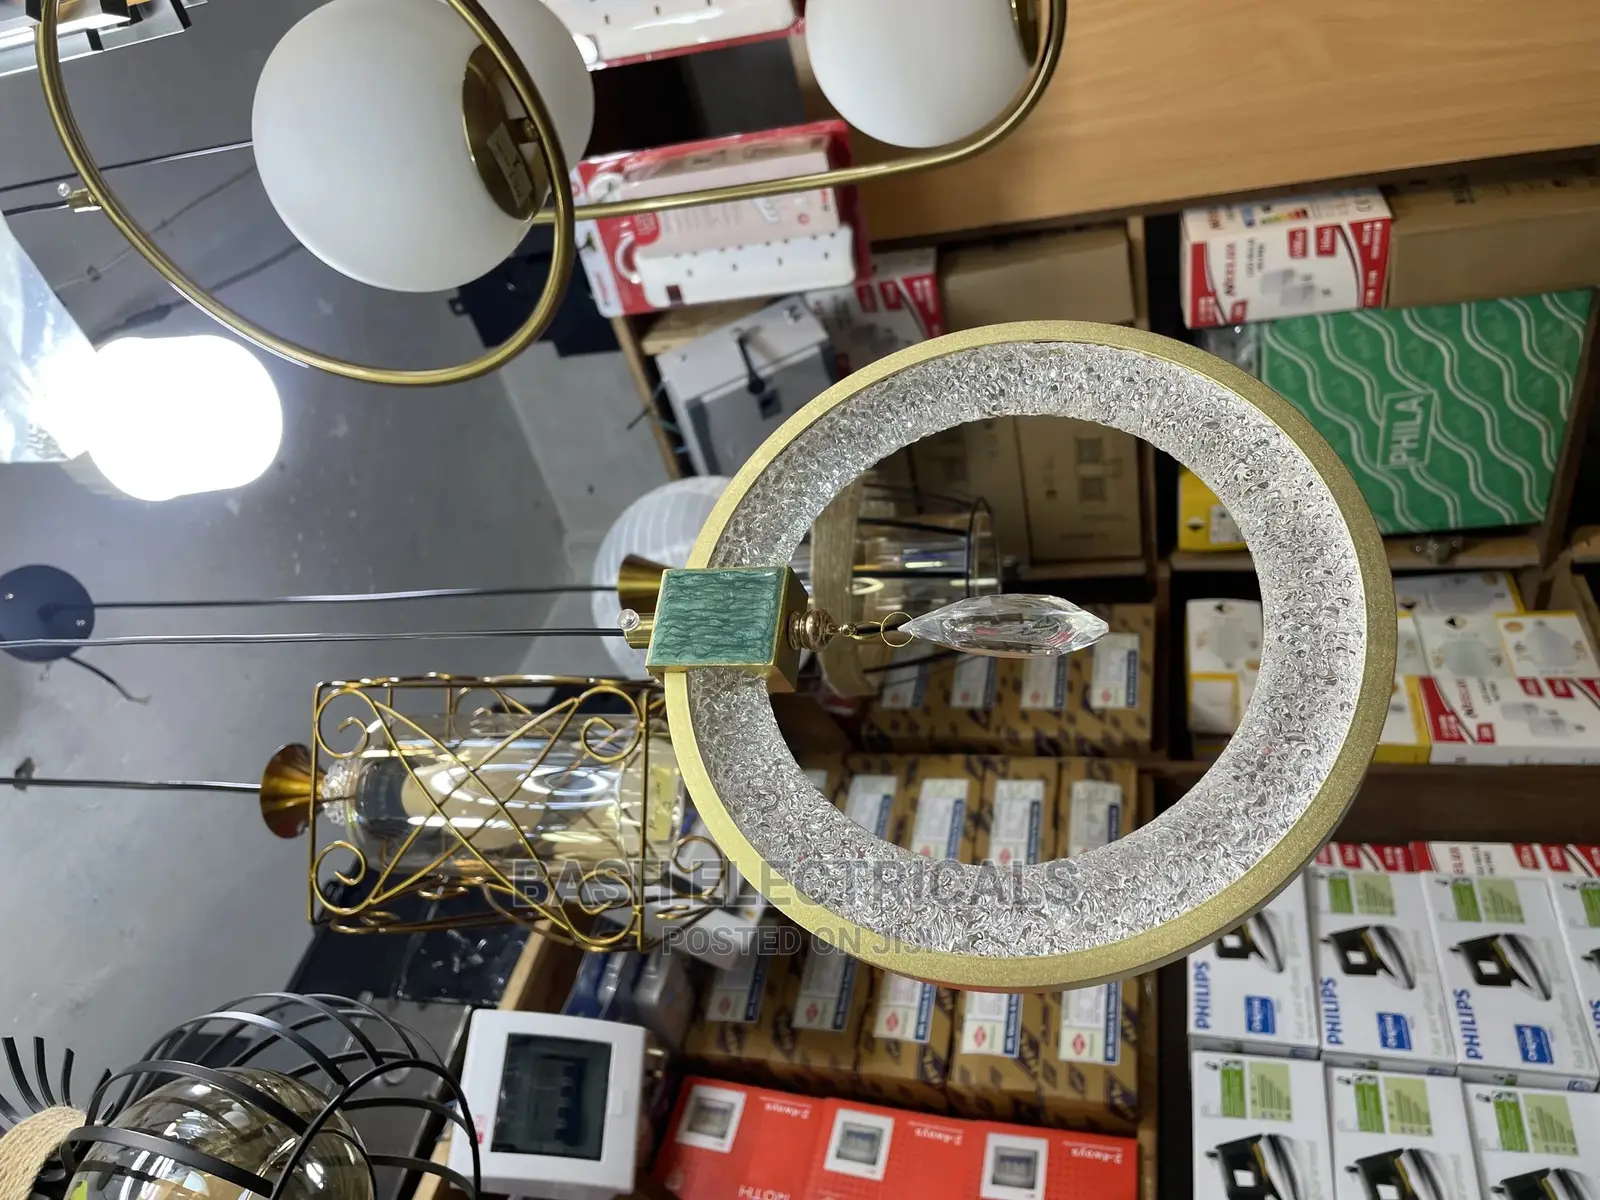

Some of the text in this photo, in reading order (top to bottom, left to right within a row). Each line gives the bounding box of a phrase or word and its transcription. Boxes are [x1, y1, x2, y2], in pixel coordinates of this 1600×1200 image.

[1387, 393, 1426, 466] PHILA
[1194, 960, 1212, 1029] PHILIPS
[1320, 977, 1345, 1045] PHILIPS
[1453, 988, 1484, 1060] PHILIPS
